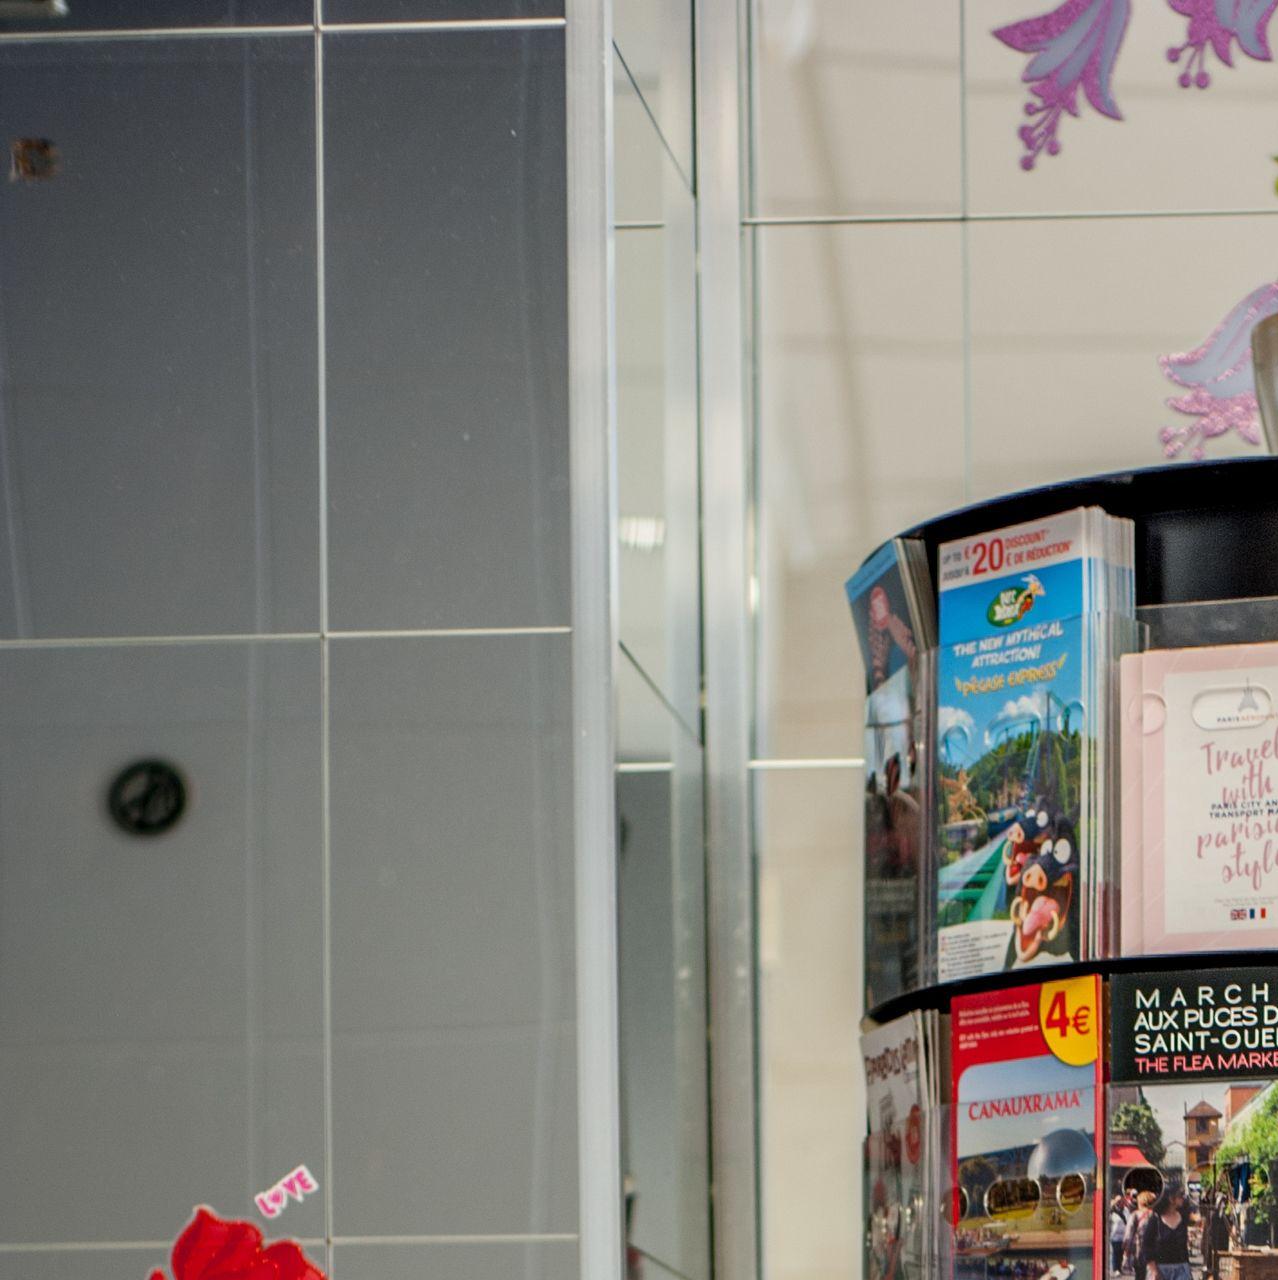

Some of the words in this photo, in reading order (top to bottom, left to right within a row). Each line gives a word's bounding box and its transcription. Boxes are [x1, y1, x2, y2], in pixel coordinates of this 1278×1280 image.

[972, 538, 1004, 575] 20
[953, 643, 976, 656] THE
[979, 636, 1004, 649] NEW
[1006, 622, 1063, 645] MYTHICAL
[1222, 760, 1274, 804] with
[1210, 809, 1264, 819] TRANSPORT
[1211, 801, 1237, 811] PARIS
[1241, 800, 1261, 810] CITY
[1046, 990, 1090, 1037] 4€
[1134, 1010, 1178, 1032] AUX
[1184, 1006, 1258, 1030] PUCES
[1135, 1056, 1169, 1074] THE
[1173, 1054, 1213, 1072] FLEA
[968, 1089, 1080, 1121] CANAUXRAMA
